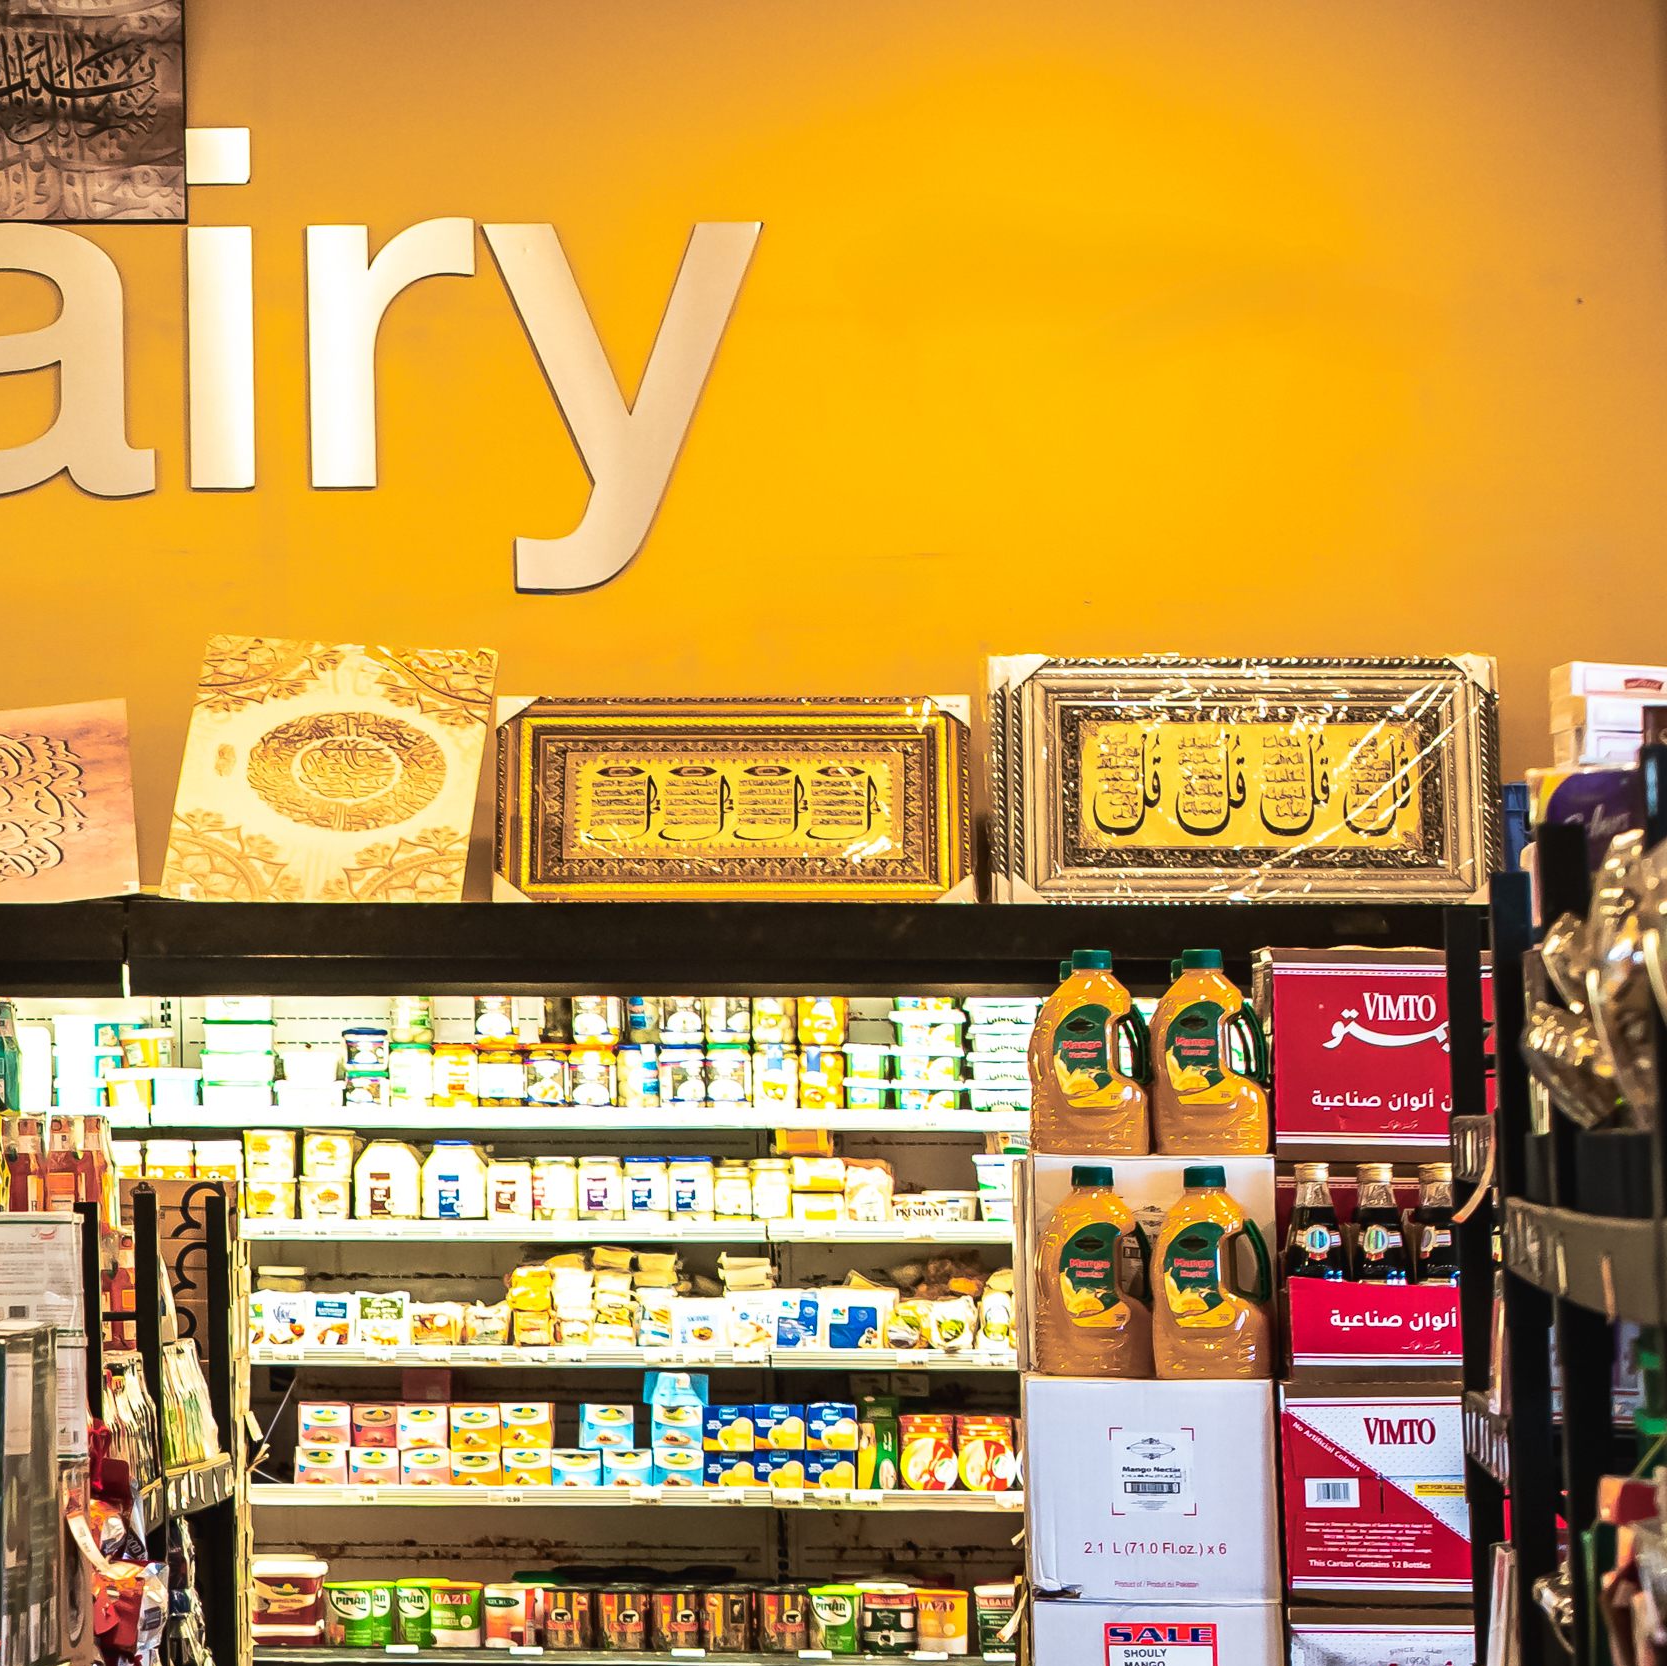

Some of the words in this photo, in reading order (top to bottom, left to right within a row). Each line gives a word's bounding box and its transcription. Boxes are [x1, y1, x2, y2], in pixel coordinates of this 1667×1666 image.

[1363, 992, 1436, 1022] VIMTO
[1062, 1040, 1102, 1049] Mango
[1175, 1037, 1215, 1047] Mango
[1069, 1258, 1110, 1269] Mango
[1174, 1258, 1215, 1268] Mango
[1363, 1417, 1436, 1445] VIMTO
[1122, 1466, 1152, 1474] Mango
[1084, 1542, 1104, 1554] 2.1
[1113, 1542, 1121, 1554] L
[1219, 1543, 1227, 1555] 6
[1309, 1559, 1325, 1567] This
[1327, 1560, 1354, 1568] Carton
[1355, 1560, 1390, 1569] Contains
[1403, 1561, 1431, 1569] Bottles
[1109, 1627, 1213, 1643] SALE
[1124, 1648, 1167, 1658] SHOULY
